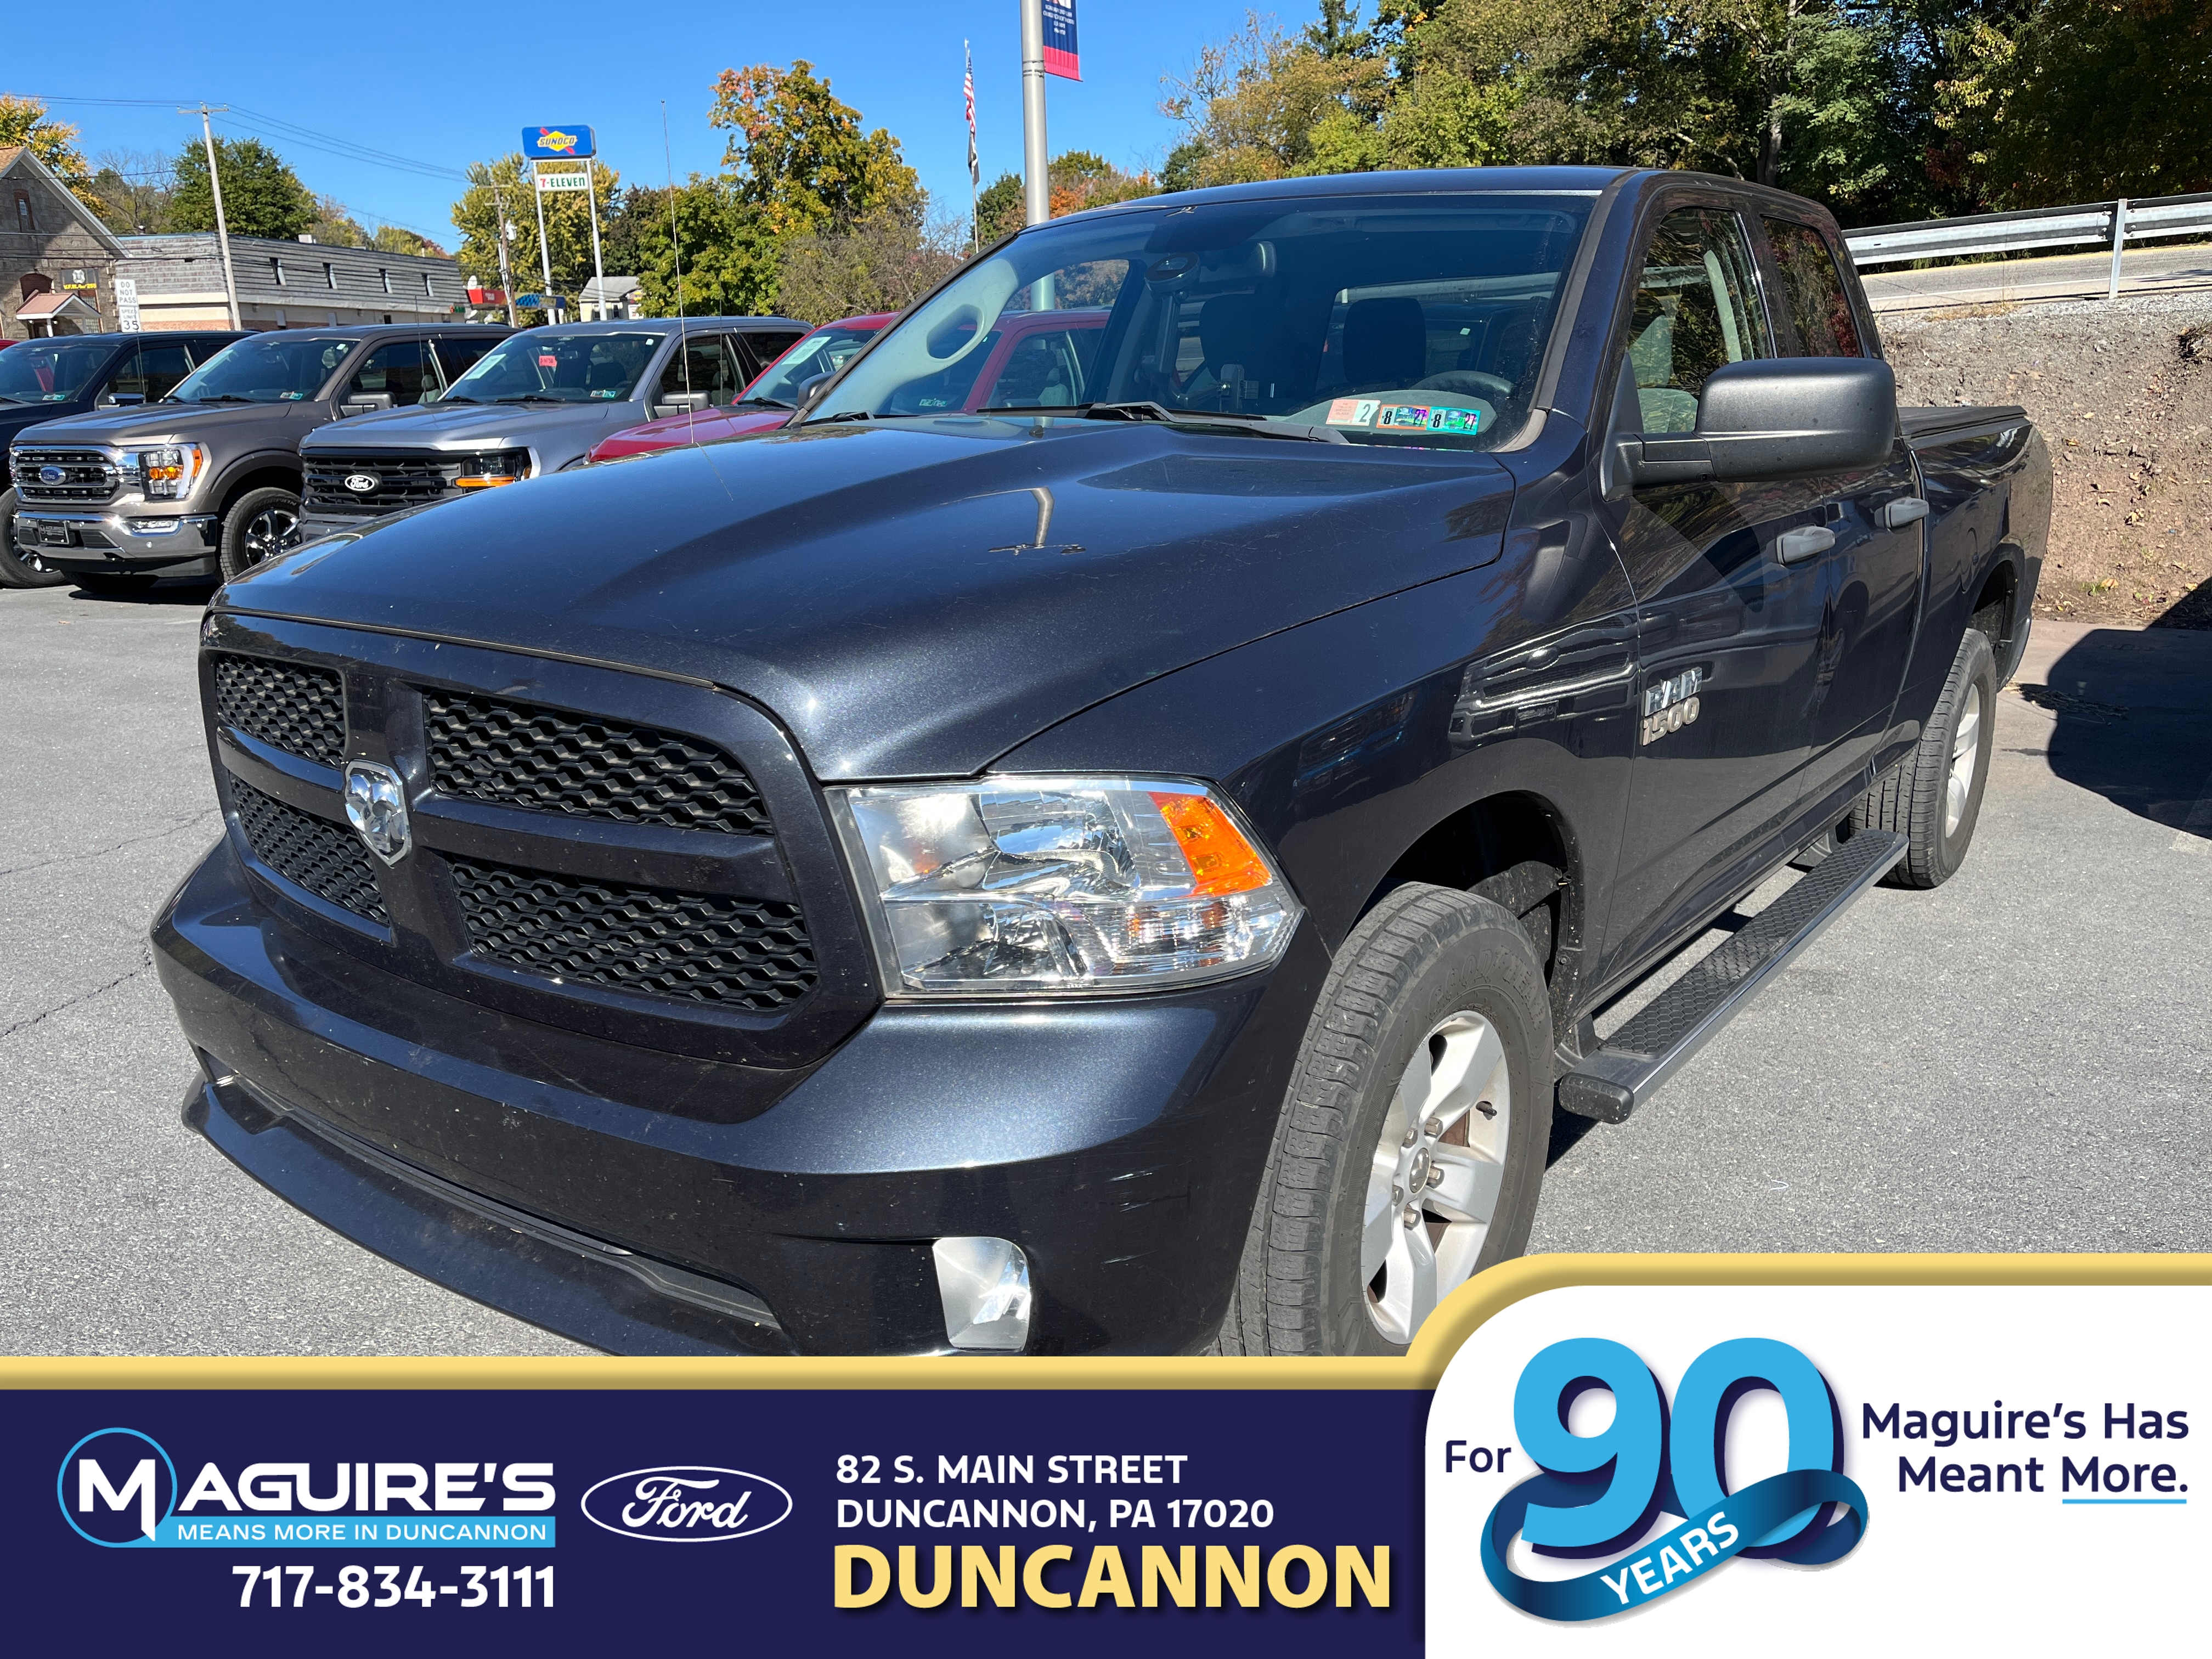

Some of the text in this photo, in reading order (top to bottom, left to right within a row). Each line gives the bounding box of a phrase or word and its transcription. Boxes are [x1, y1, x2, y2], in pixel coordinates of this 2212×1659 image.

[539, 137, 574, 146] SUNOCO
[123, 320, 139, 330] 35
[1359, 403, 1371, 422] 2
[1383, 410, 1393, 425] 8
[1432, 414, 1442, 428] 8
[1463, 413, 1477, 430] 27
[350, 476, 369, 488] Ford
[1641, 667, 1702, 717] RAM
[1639, 696, 1700, 747] 1500
